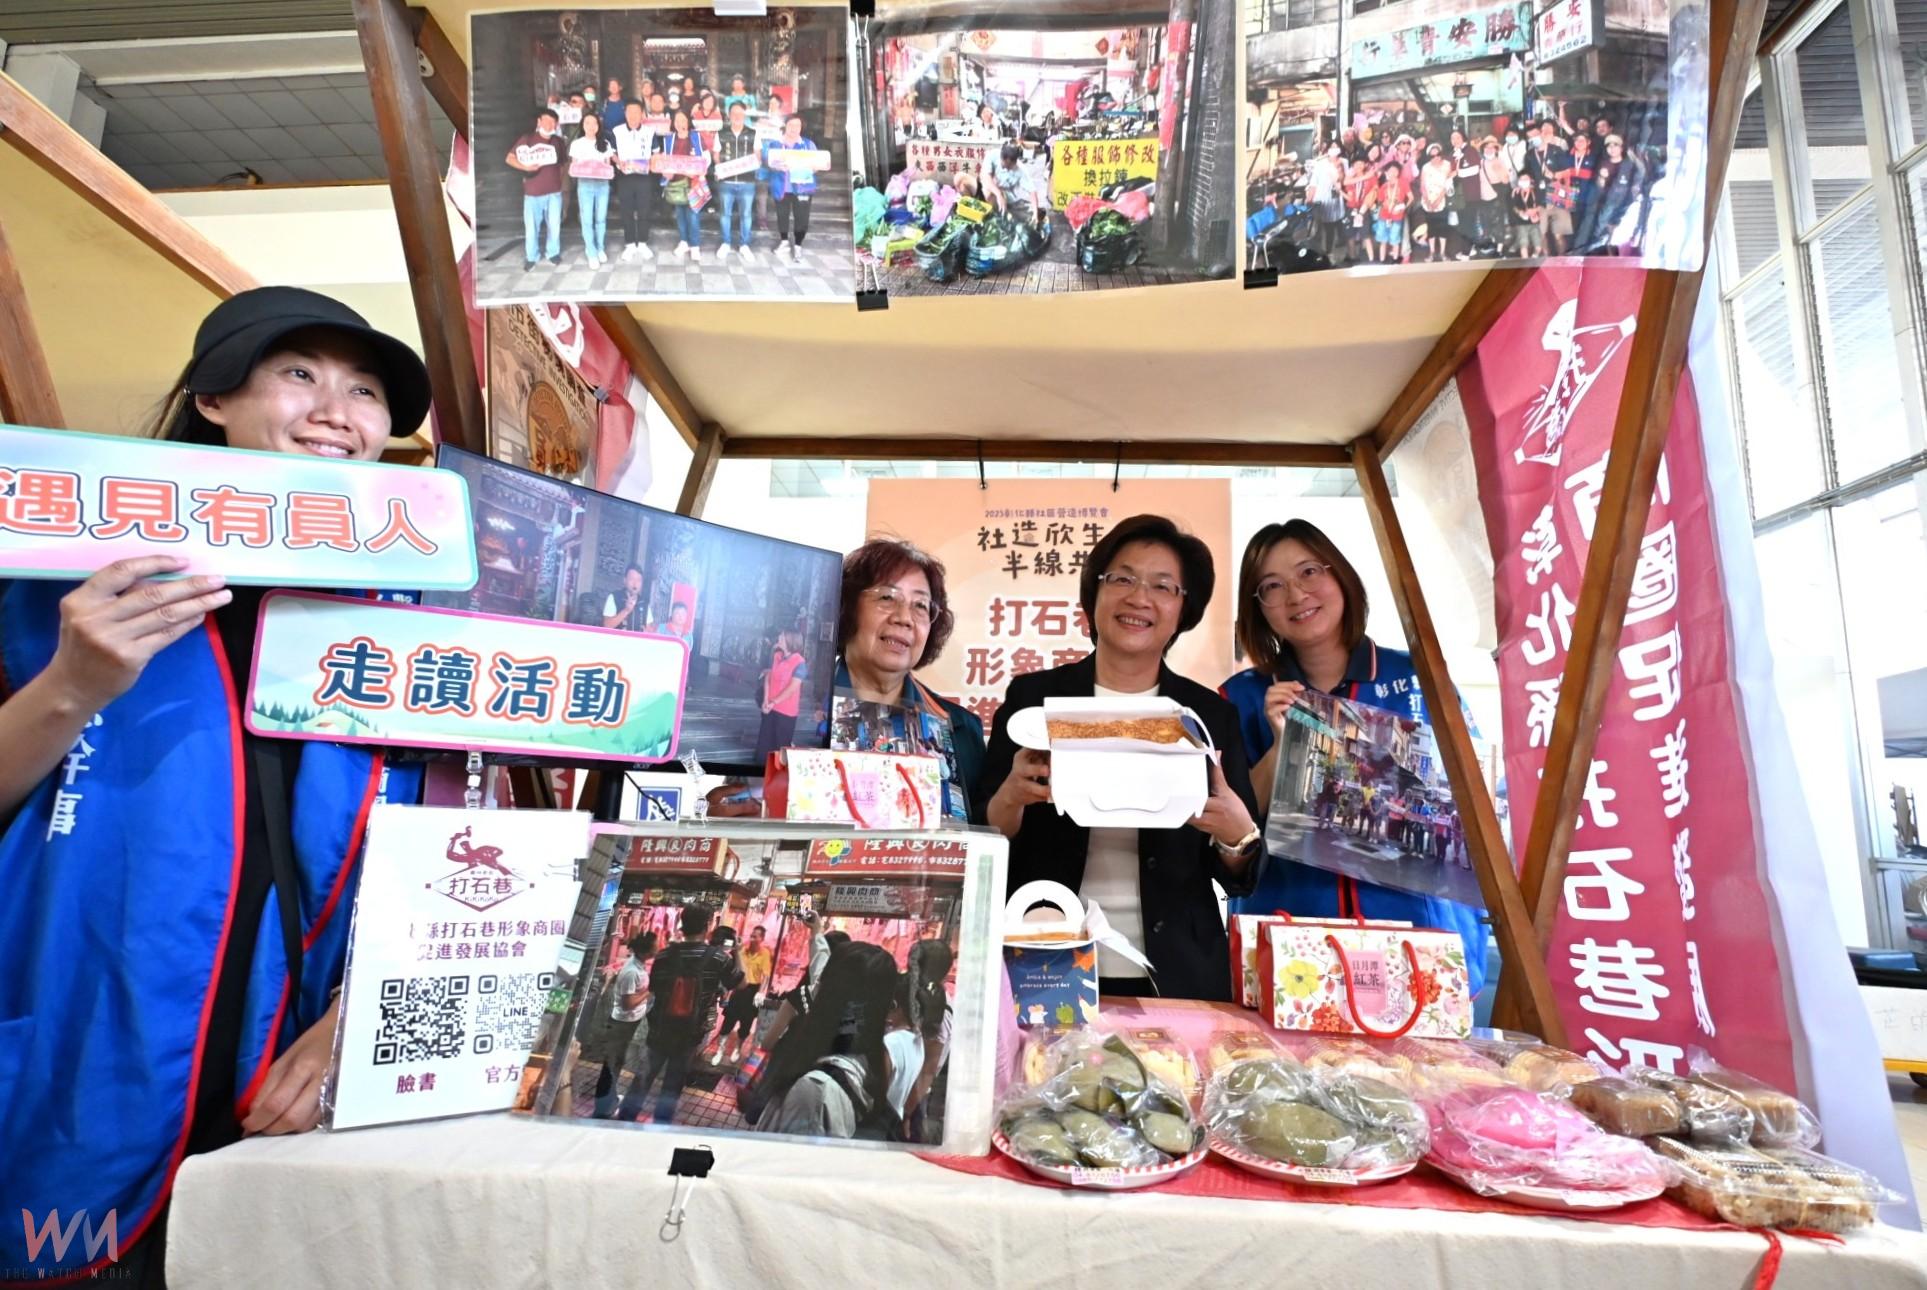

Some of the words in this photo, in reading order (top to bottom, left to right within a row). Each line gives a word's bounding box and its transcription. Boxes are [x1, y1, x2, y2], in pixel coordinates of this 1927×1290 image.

[1063, 144, 1155, 166] 各種服飾修改
[0, 467, 437, 555] 遇見有員人
[977, 520, 1105, 552] 社造欣生
[314, 638, 630, 728] 走讀活動
[449, 876, 513, 896] 打石巷
[410, 920, 565, 940] 縣打石巷形象商圈
[1353, 972, 1381, 987] 紅茶
[502, 1006, 528, 1018] LINE
[395, 1072, 437, 1094] 臉書
